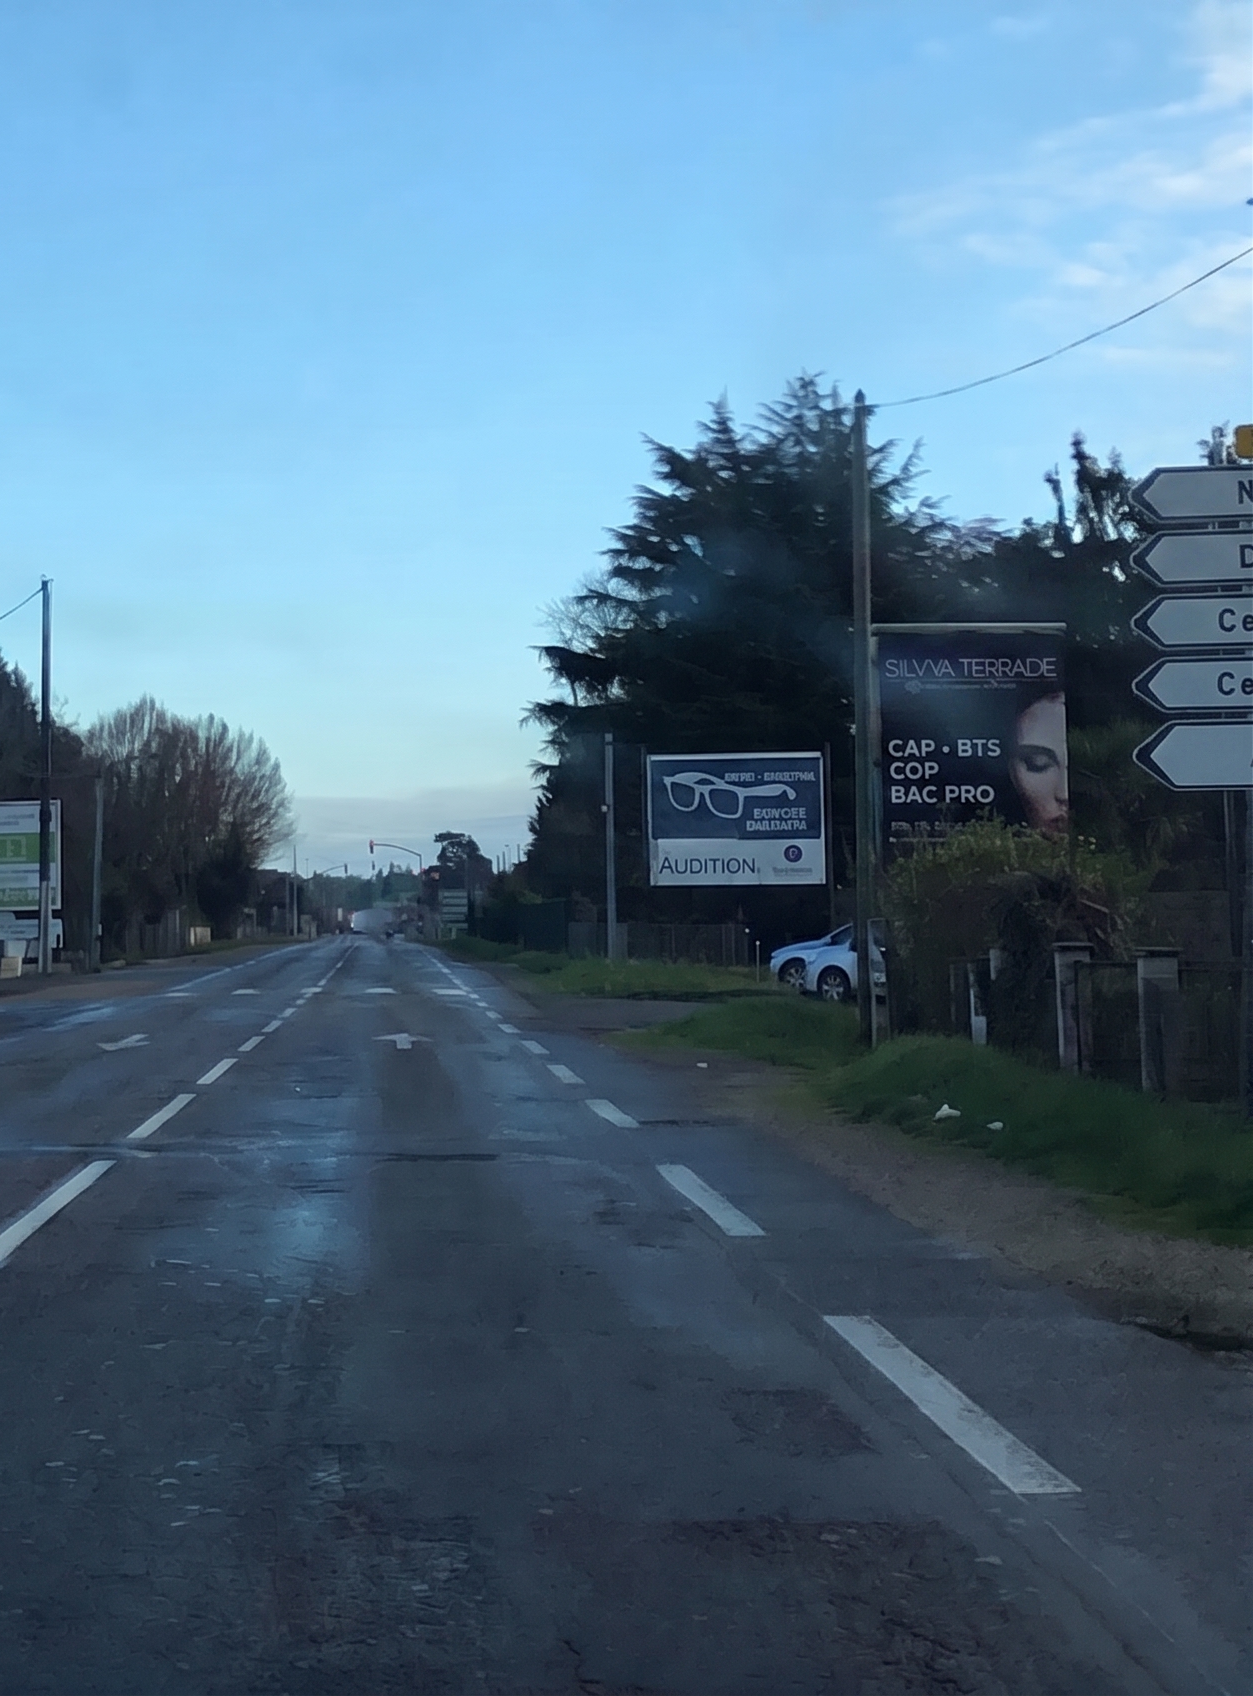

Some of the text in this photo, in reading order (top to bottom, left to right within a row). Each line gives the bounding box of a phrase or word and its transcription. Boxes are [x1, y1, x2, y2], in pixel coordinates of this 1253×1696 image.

[1218, 608, 1253, 632] Ce
[958, 658, 1057, 677] TERRADE
[1216, 671, 1253, 695] Ce
[888, 739, 1001, 757] CAP BTS
[889, 761, 939, 780] COP
[891, 785, 995, 803] BAC PRO
[659, 857, 756, 874] AUDITION
